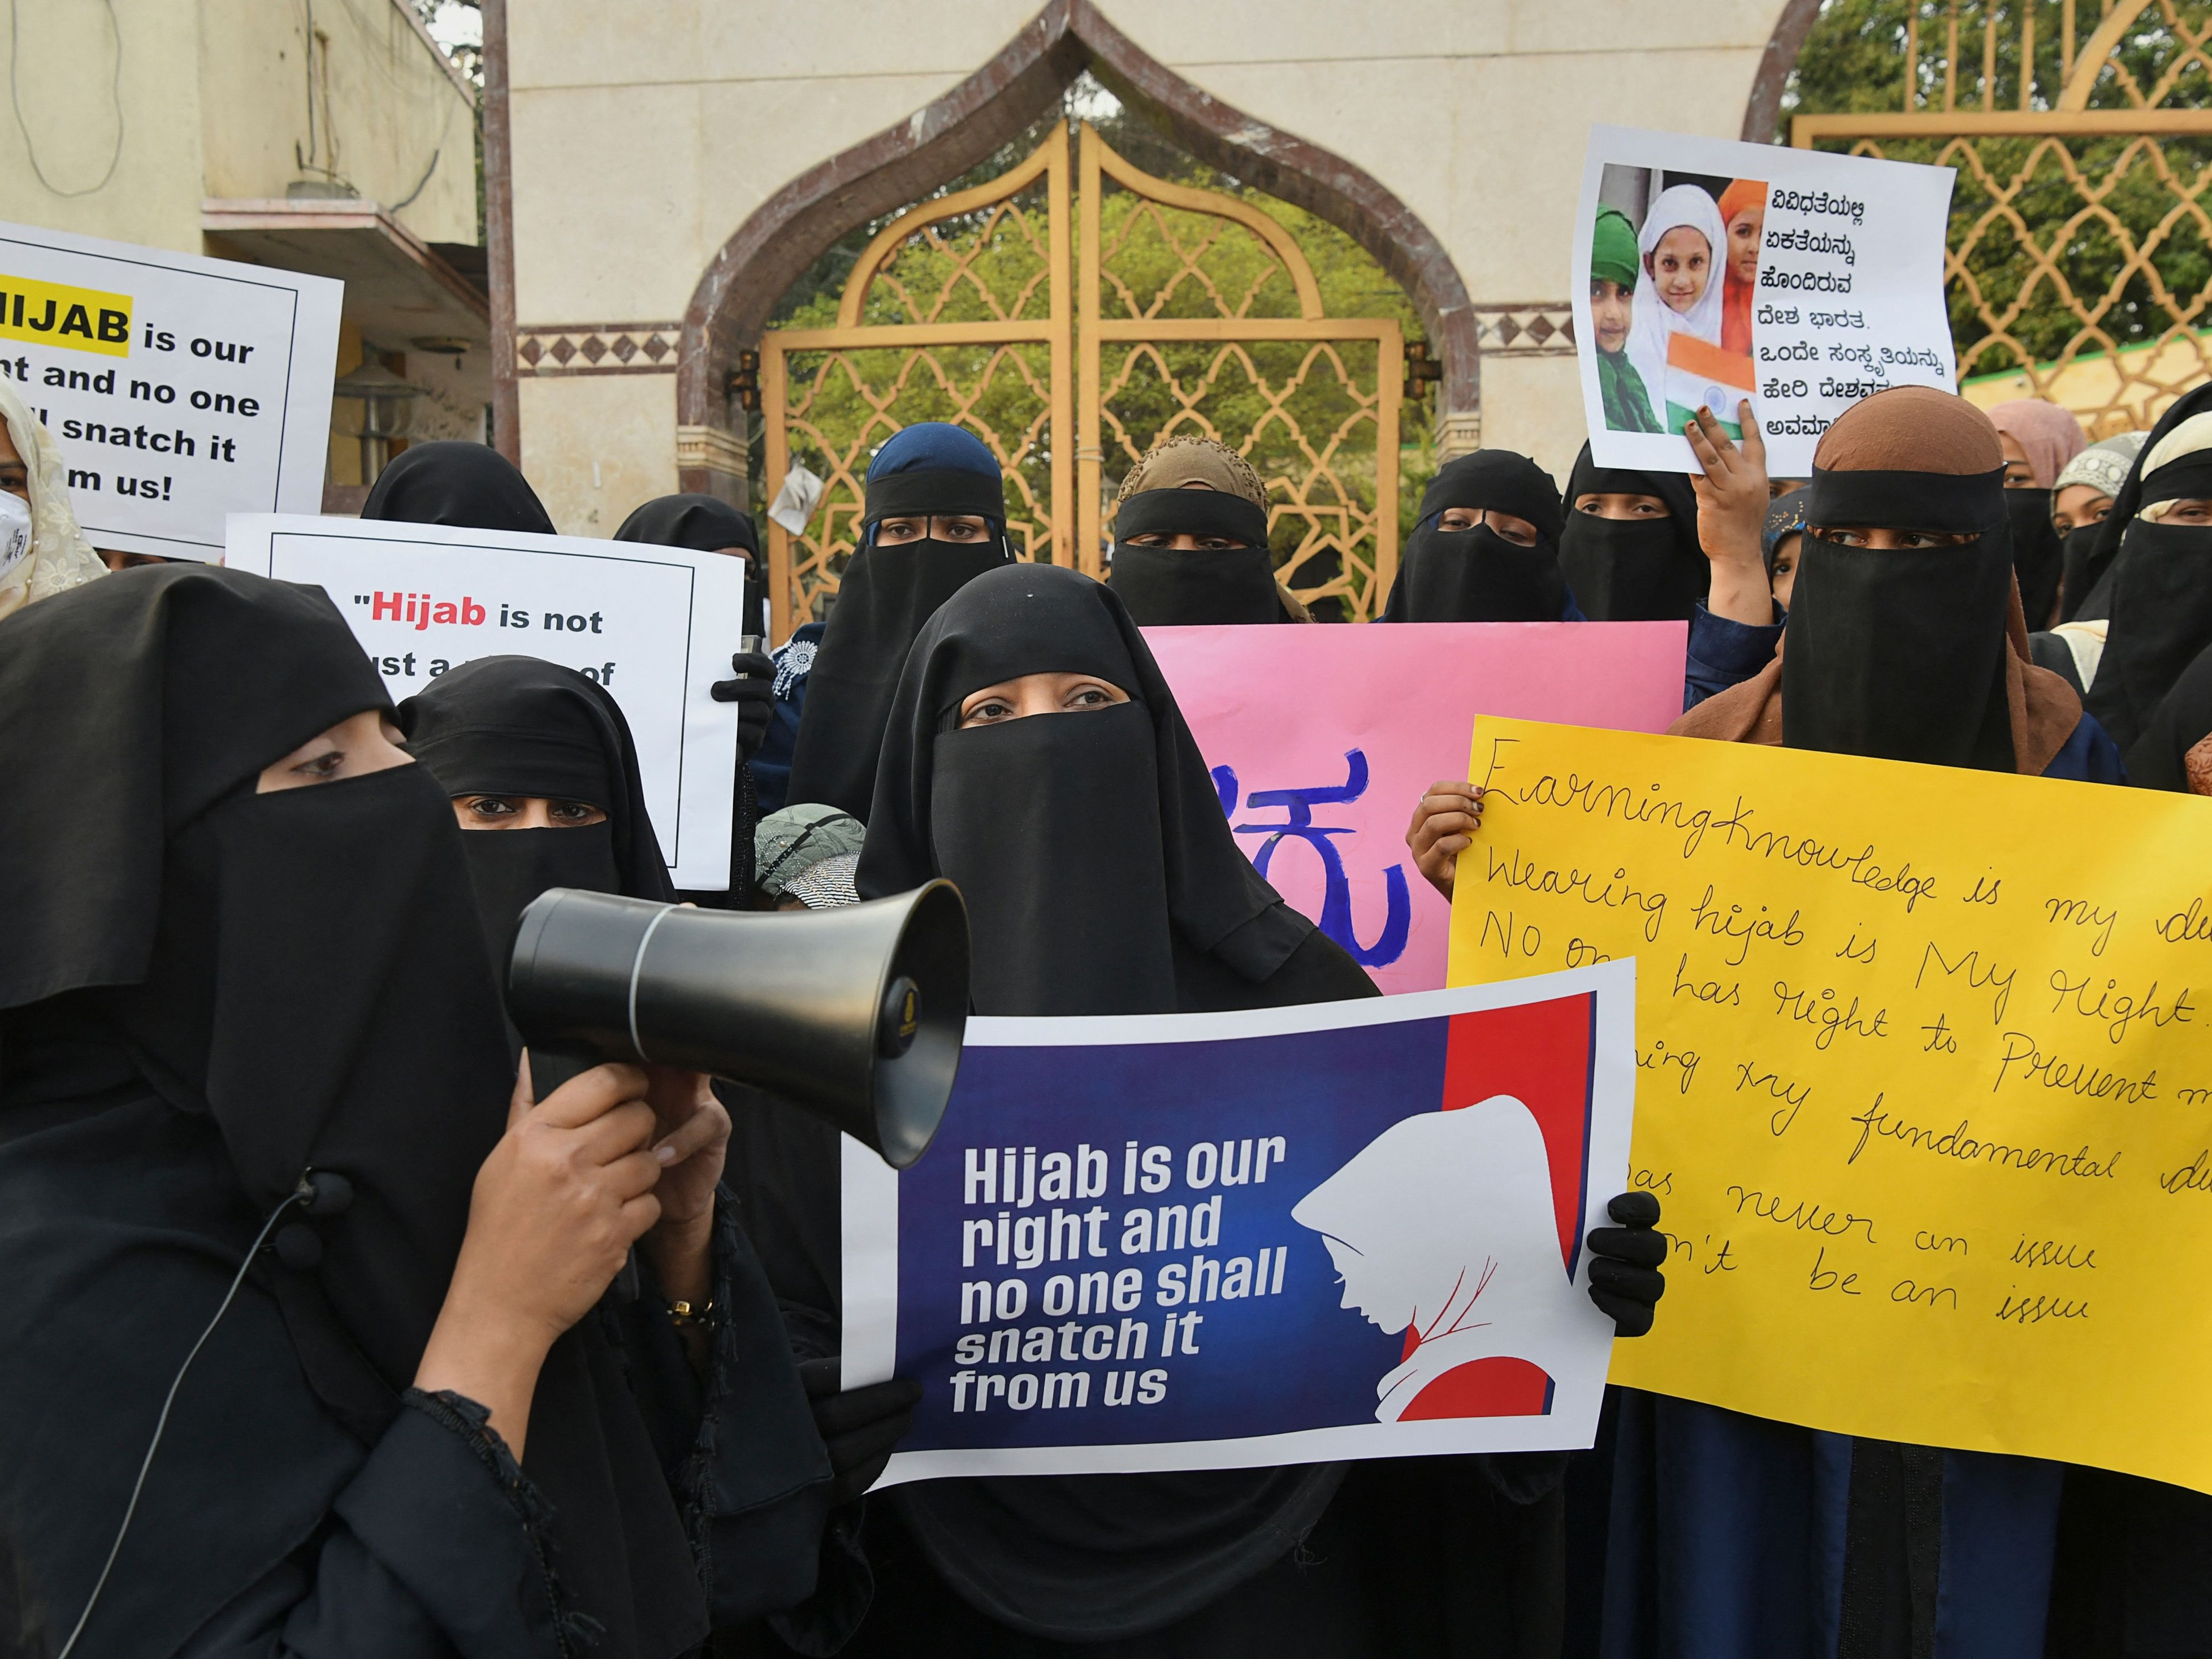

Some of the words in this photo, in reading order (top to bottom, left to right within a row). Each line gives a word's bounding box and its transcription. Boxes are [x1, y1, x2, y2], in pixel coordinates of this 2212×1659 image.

[1772, 189, 1865, 226] ವಿವಿಧತೆಯಲ್ಲಿ
[1766, 228, 1856, 267] ಏಕತೆಯನ್ನು
[1761, 265, 1852, 293] ಹೊಂದಿರುವ
[0, 292, 129, 343] IJAB
[144, 323, 176, 352] is
[191, 337, 254, 363] our
[1758, 304, 1800, 324] ದೇಶ
[1760, 340, 1820, 361] ಒಂದೇ
[44, 366, 115, 395] and
[130, 379, 176, 404] no
[190, 391, 260, 417] one
[1763, 378, 1808, 398] ಹೇರಿ
[62, 419, 196, 456] snatch
[210, 435, 236, 462] it
[117, 476, 172, 501] us!
[354, 591, 486, 631] "Hijab
[500, 604, 530, 629] is
[544, 612, 603, 634] not
[429, 659, 450, 678] a
[1482, 738, 1711, 858] Earning
[1963, 867, 2002, 904] is
[2045, 898, 2117, 956] my
[1487, 846, 1667, 942] Wearing
[1690, 885, 1804, 966] hijab
[1836, 922, 1876, 963] is
[1915, 941, 2017, 1025] My
[1480, 911, 1540, 958] No
[1566, 938, 1610, 968] on
[1673, 953, 1740, 1006] has
[1774, 981, 1889, 1050] right
[1921, 1013, 1956, 1054] to
[1848, 1092, 2122, 1179] fundamental
[964, 1143, 1109, 1208] Hijab
[1123, 1141, 1172, 1195] is
[1186, 1136, 1287, 1189] our
[963, 1206, 1109, 1270] right
[1120, 1195, 1222, 1254] and
[1626, 1163, 1673, 1195] as
[1727, 1186, 1878, 1244] never
[1915, 1230, 1967, 1256] an
[2010, 1233, 2096, 1268] issue
[961, 1277, 1028, 1324] no
[1042, 1268, 1143, 1316] one
[1156, 1246, 1287, 1307] shall
[1809, 1246, 1860, 1294] be
[1891, 1280, 1956, 1310] an
[1996, 1284, 2089, 1324] issue
[954, 1317, 1149, 1365] snatch
[1161, 1310, 1203, 1357] it
[950, 1370, 1090, 1413] from
[1103, 1368, 1168, 1406] us
